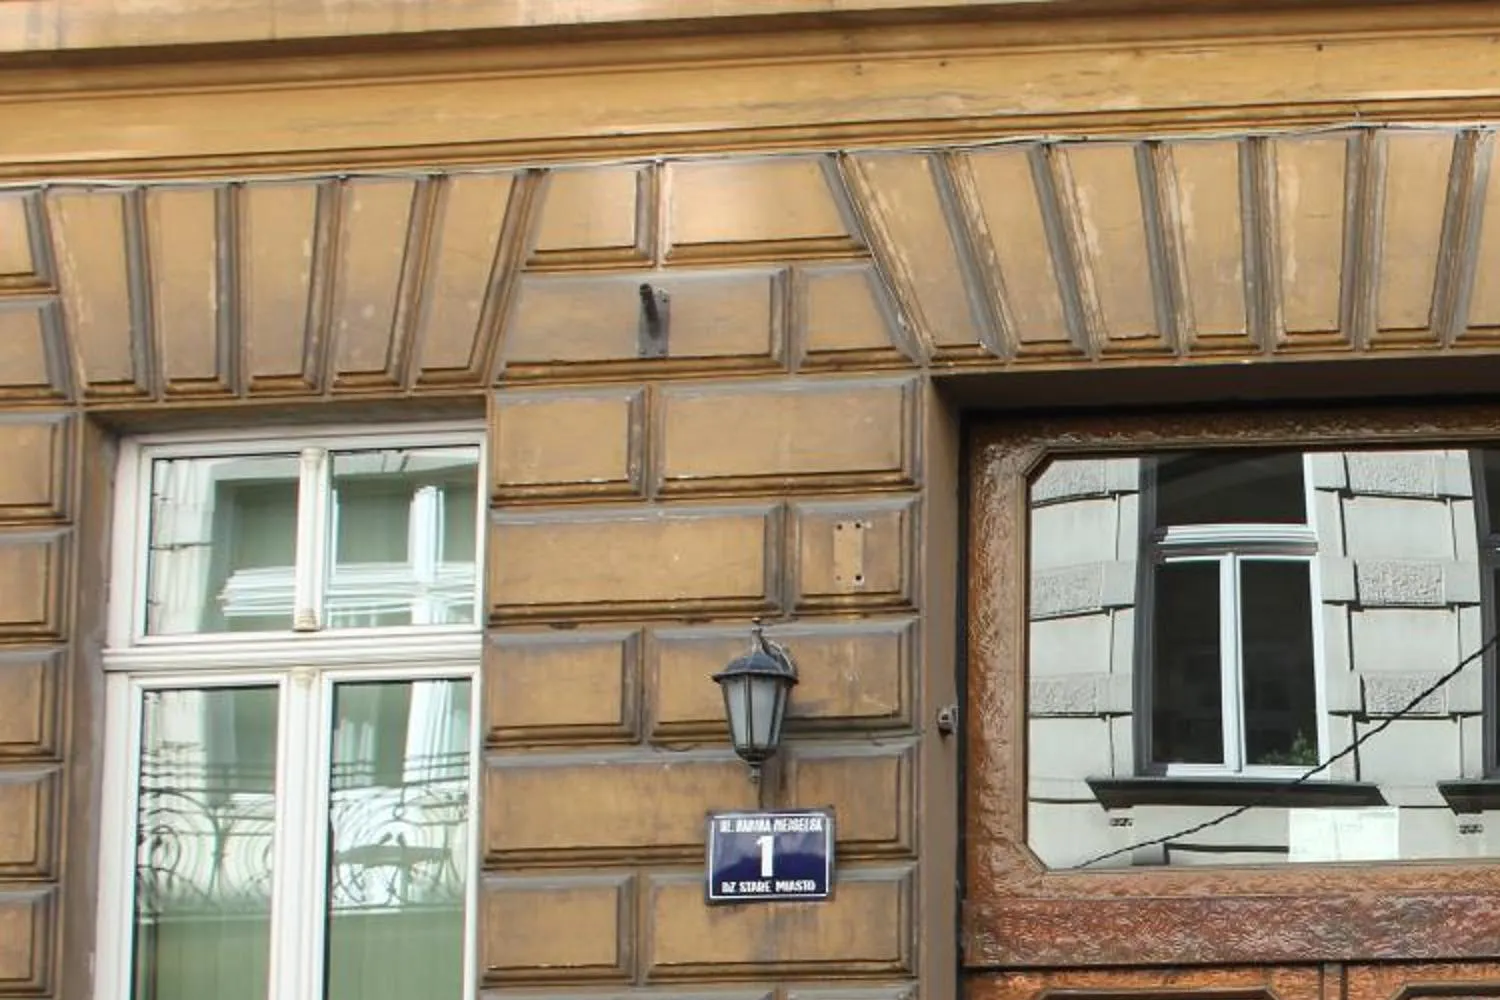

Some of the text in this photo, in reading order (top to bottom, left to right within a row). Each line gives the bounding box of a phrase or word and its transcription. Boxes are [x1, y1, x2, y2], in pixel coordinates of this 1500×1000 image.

[755, 835, 775, 878] 1
[739, 880, 772, 893] STARE
[775, 879, 816, 892] MIASTO
